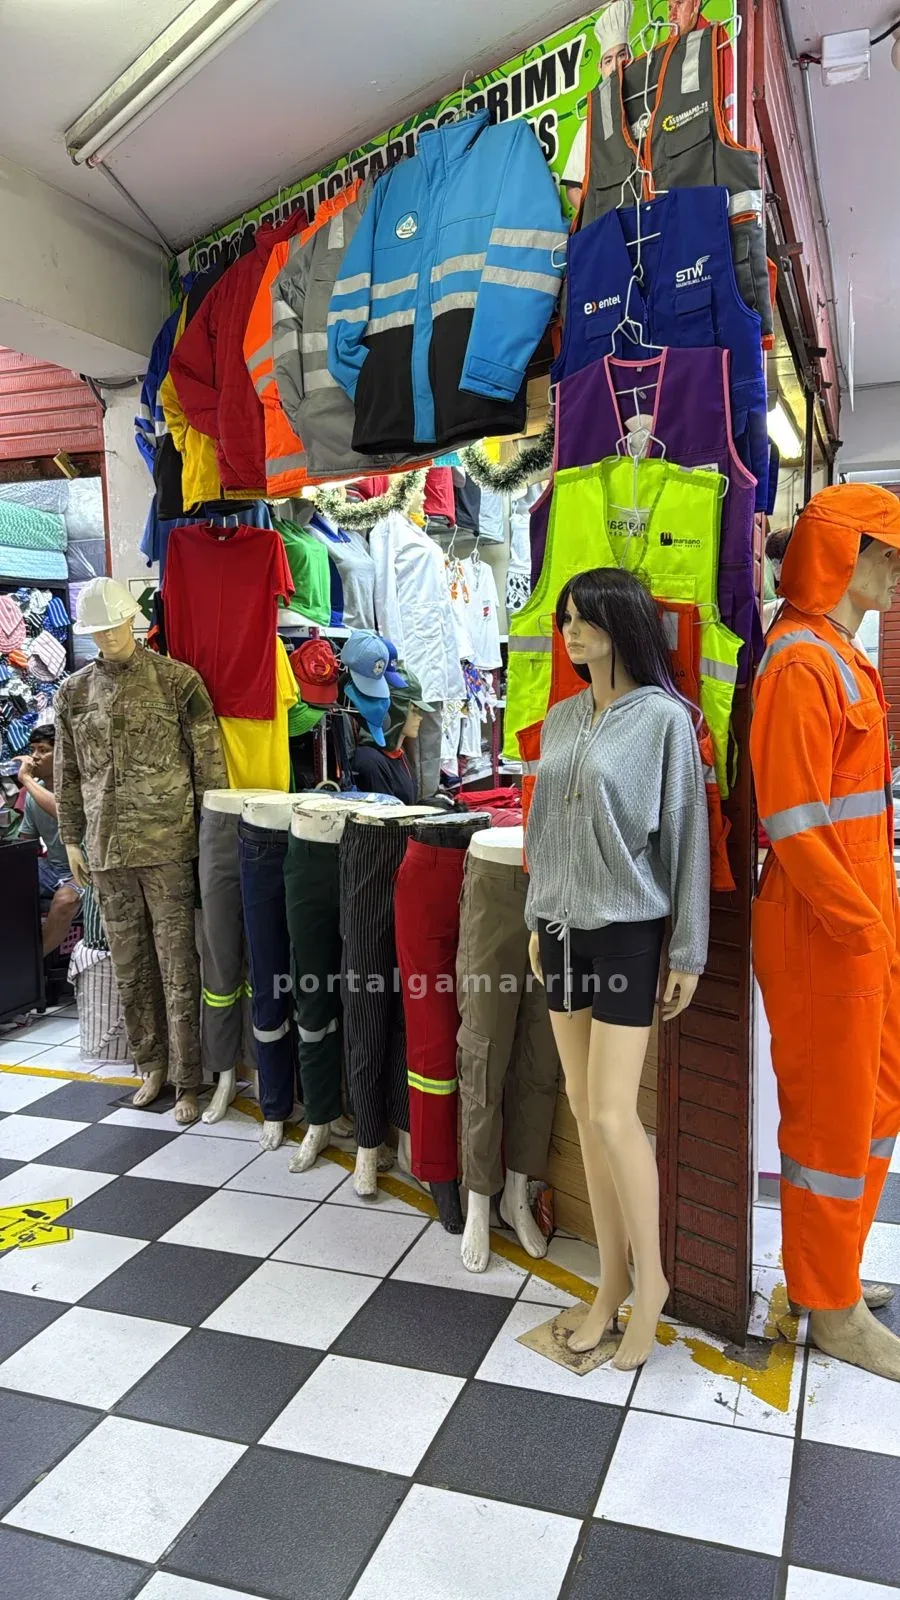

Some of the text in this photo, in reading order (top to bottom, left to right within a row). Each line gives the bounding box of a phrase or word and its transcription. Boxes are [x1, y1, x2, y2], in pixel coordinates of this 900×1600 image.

[261, 111, 457, 227] LICITARI
[676, 260, 705, 282] STW
[599, 294, 621, 308] entel
